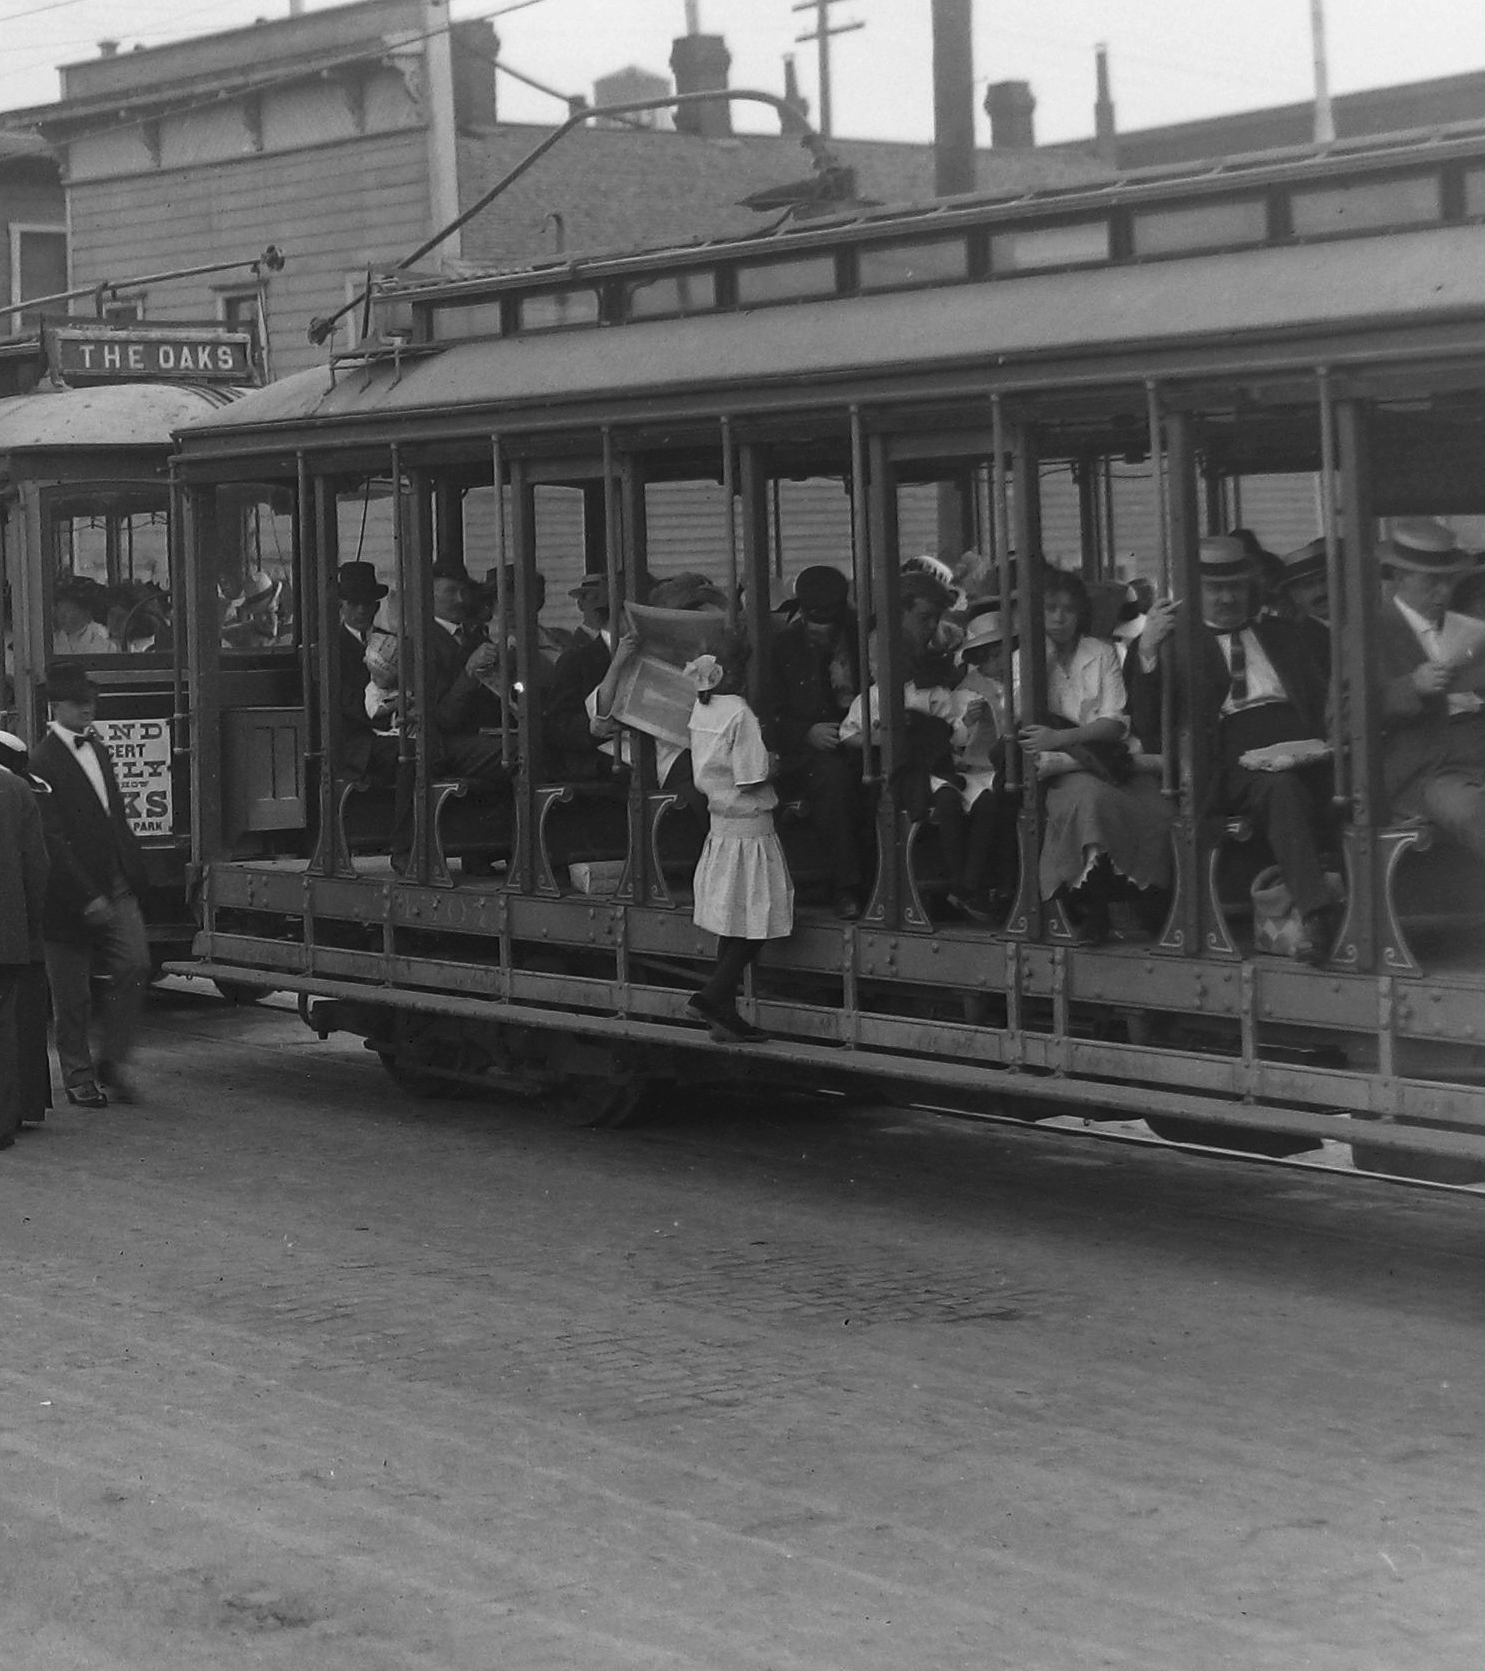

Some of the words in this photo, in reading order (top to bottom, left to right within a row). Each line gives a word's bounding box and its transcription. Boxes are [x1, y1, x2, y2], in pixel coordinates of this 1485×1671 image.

[78, 345, 145, 369] THE
[158, 345, 234, 370] OAKS
[133, 822, 162, 831] PARK
